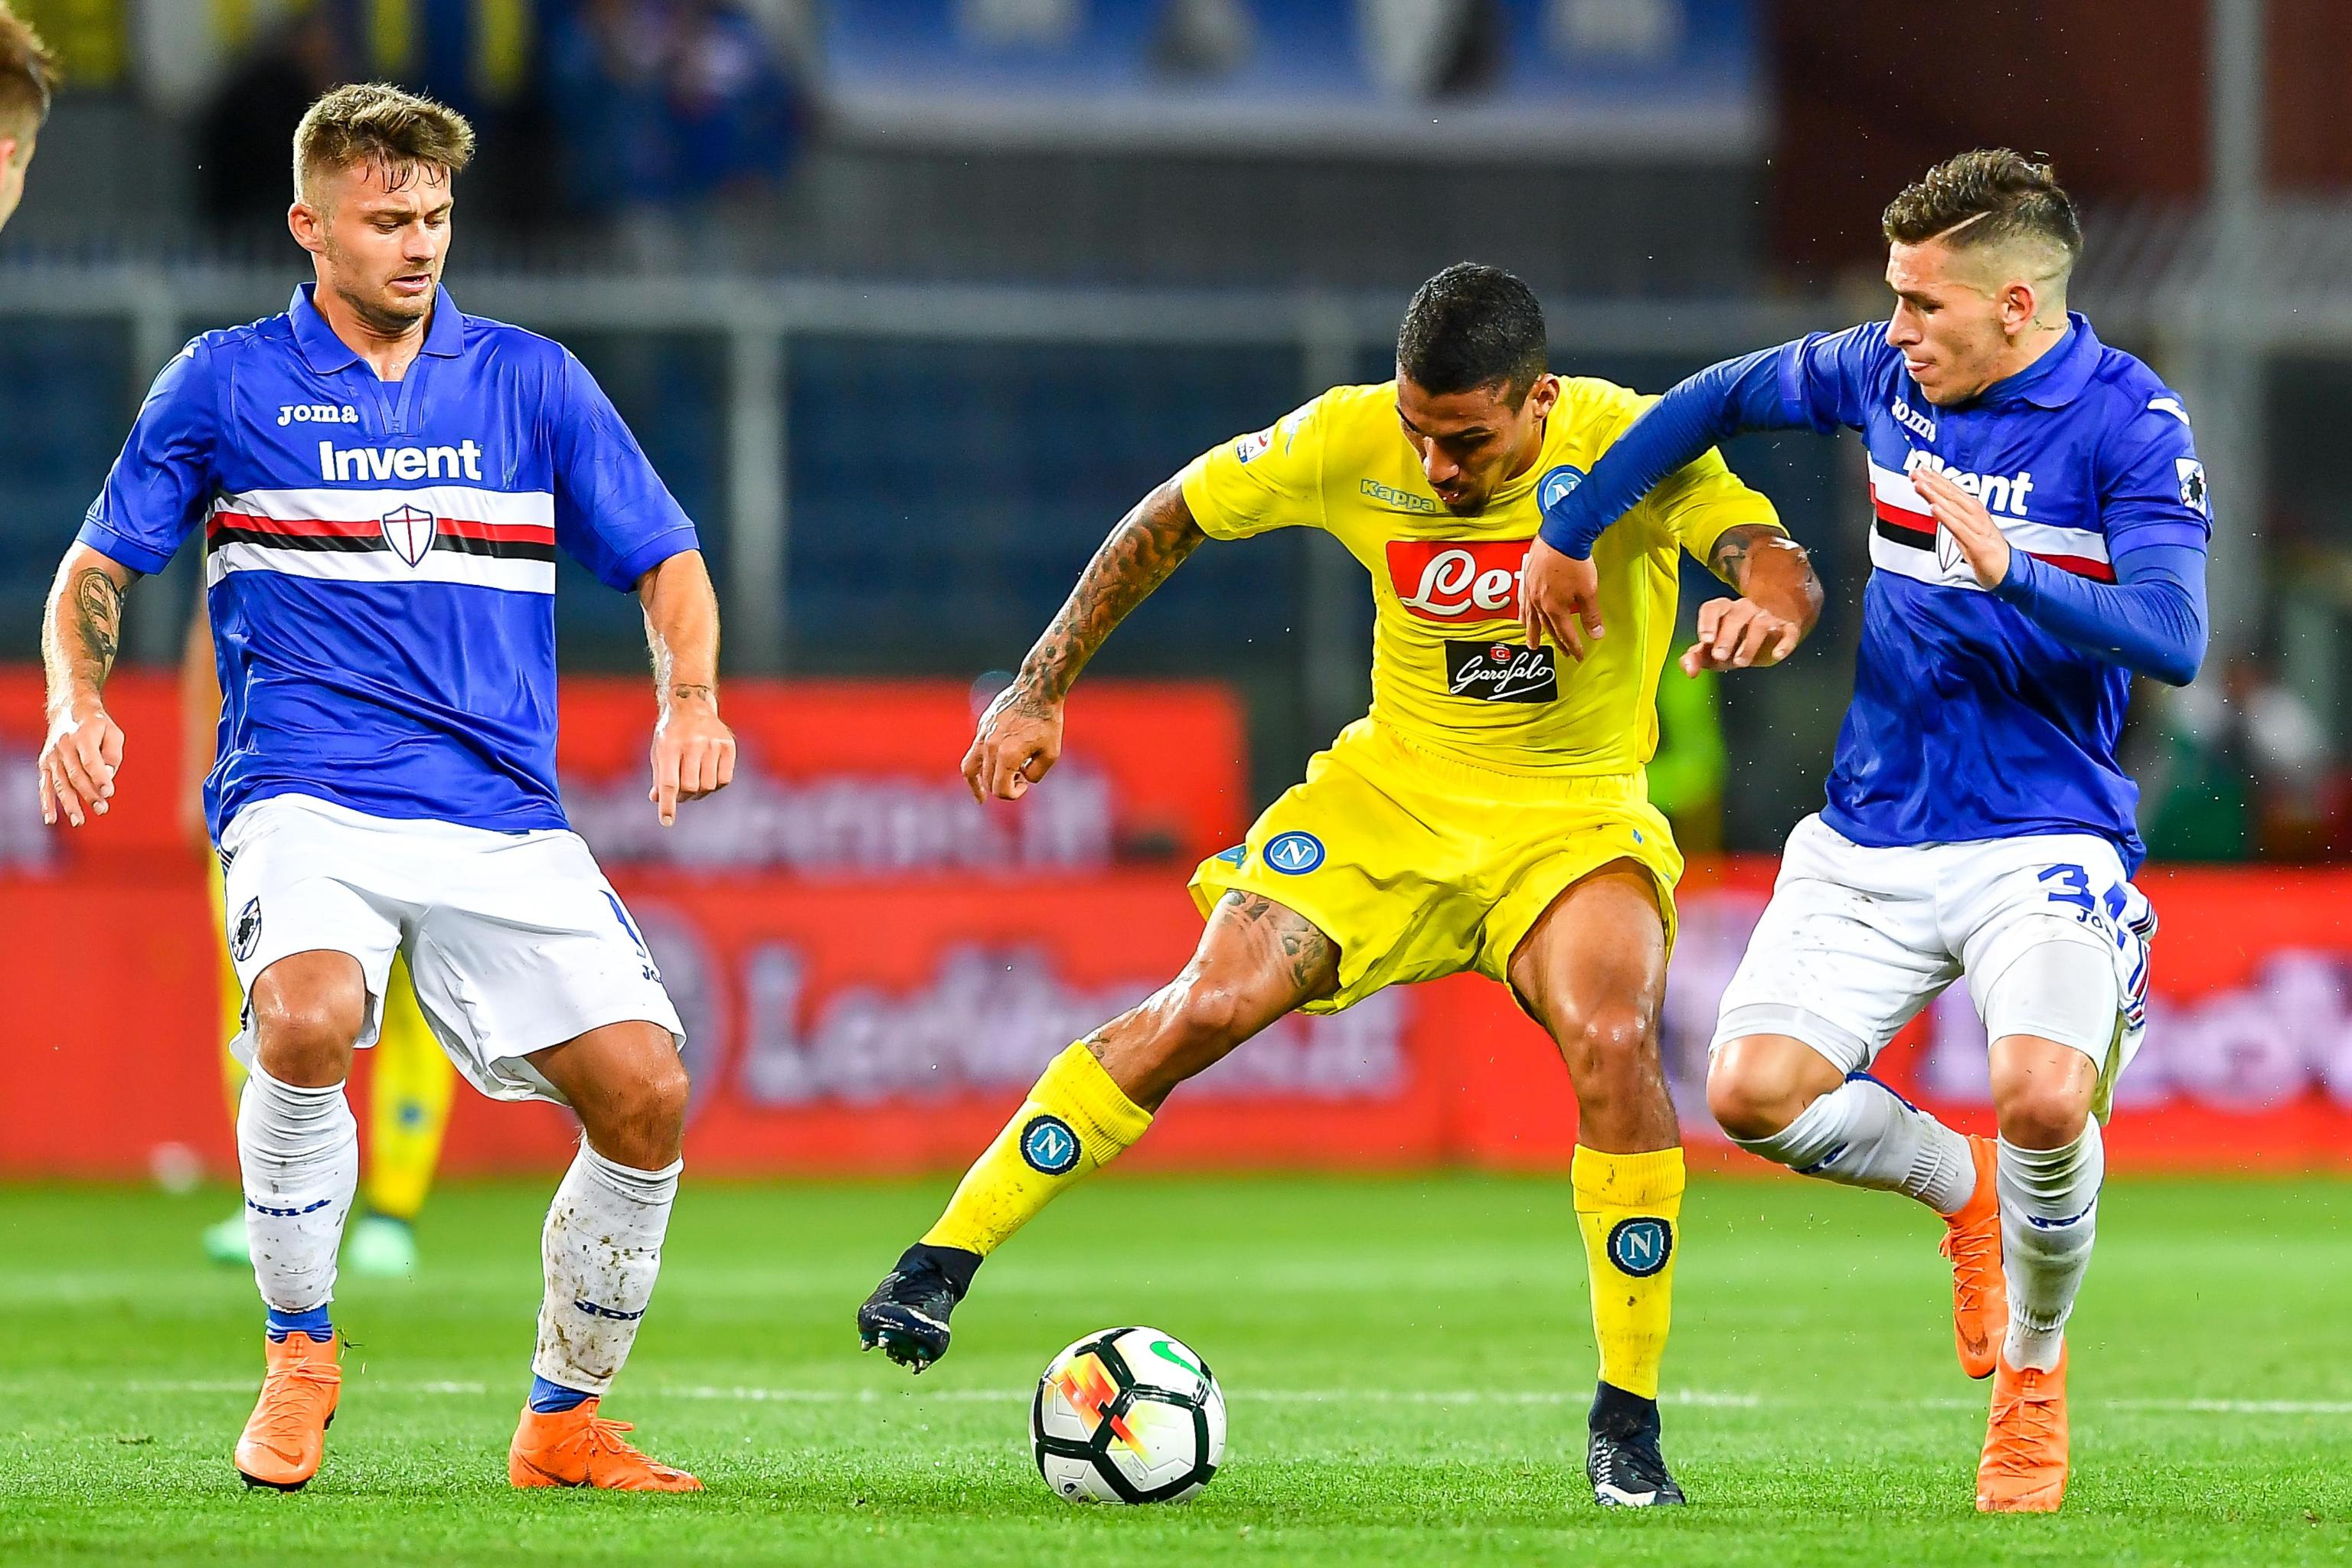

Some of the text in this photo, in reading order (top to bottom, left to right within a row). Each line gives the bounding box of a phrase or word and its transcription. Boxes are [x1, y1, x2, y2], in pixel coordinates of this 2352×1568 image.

[318, 439, 482, 481] Invent
[1361, 479, 1436, 512] Kappa
[1449, 652, 1556, 700] Garofalo
[1276, 840, 1312, 865] N
[1034, 1129, 1068, 1160] N
[1627, 1230, 1655, 1259] N
